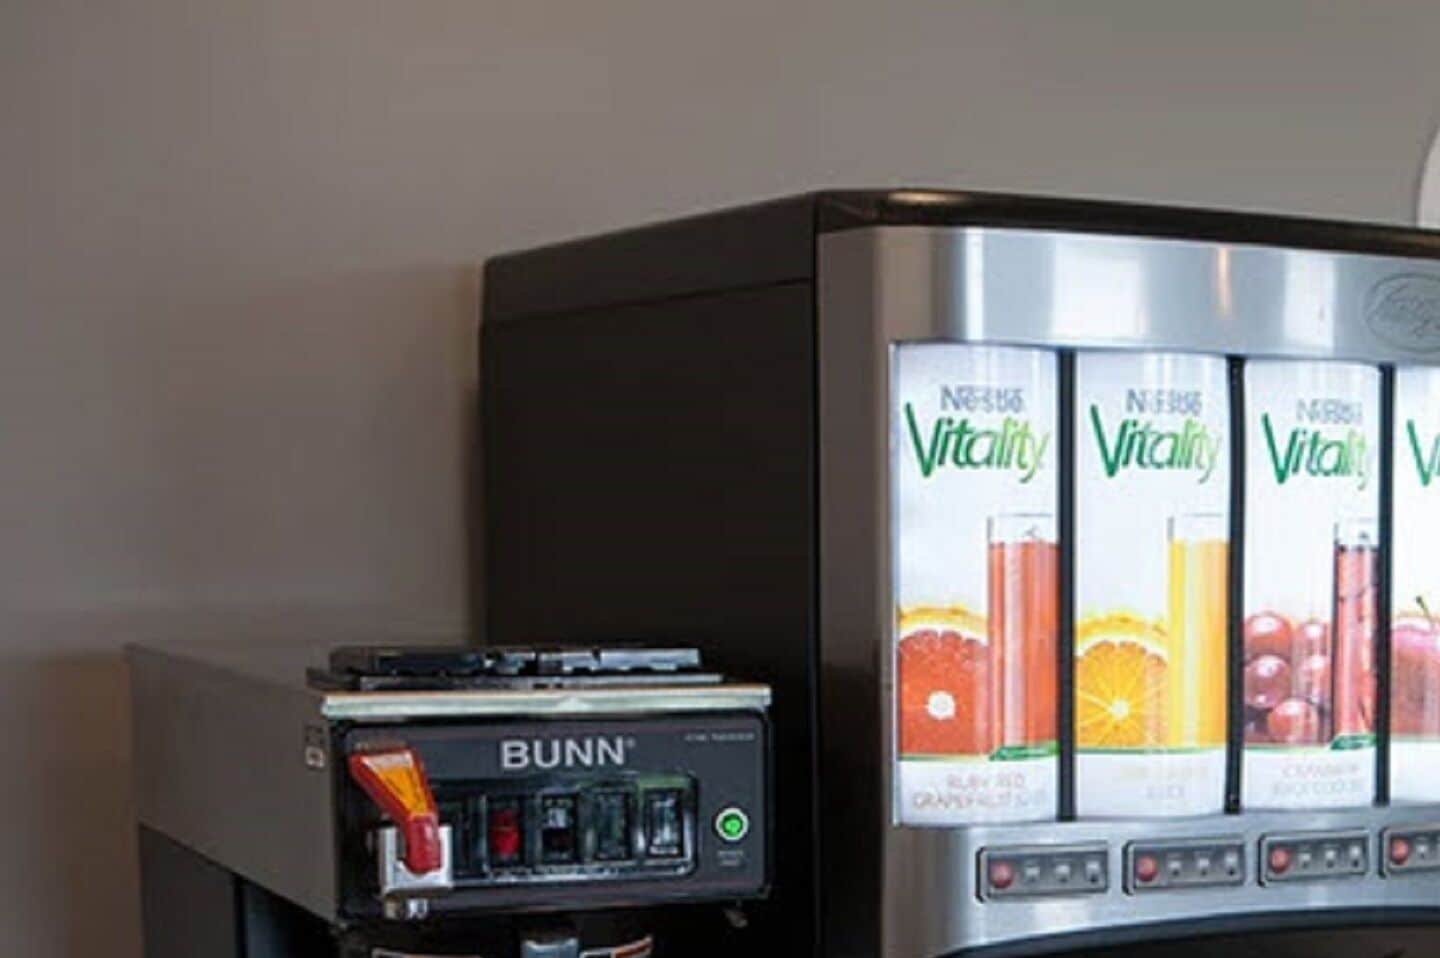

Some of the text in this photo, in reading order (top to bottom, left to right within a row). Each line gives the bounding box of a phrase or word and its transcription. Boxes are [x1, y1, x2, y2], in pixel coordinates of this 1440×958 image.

[905, 402, 1049, 484] Vitality
[1090, 403, 1223, 484] Vitality
[502, 736, 626, 770] BUNN
